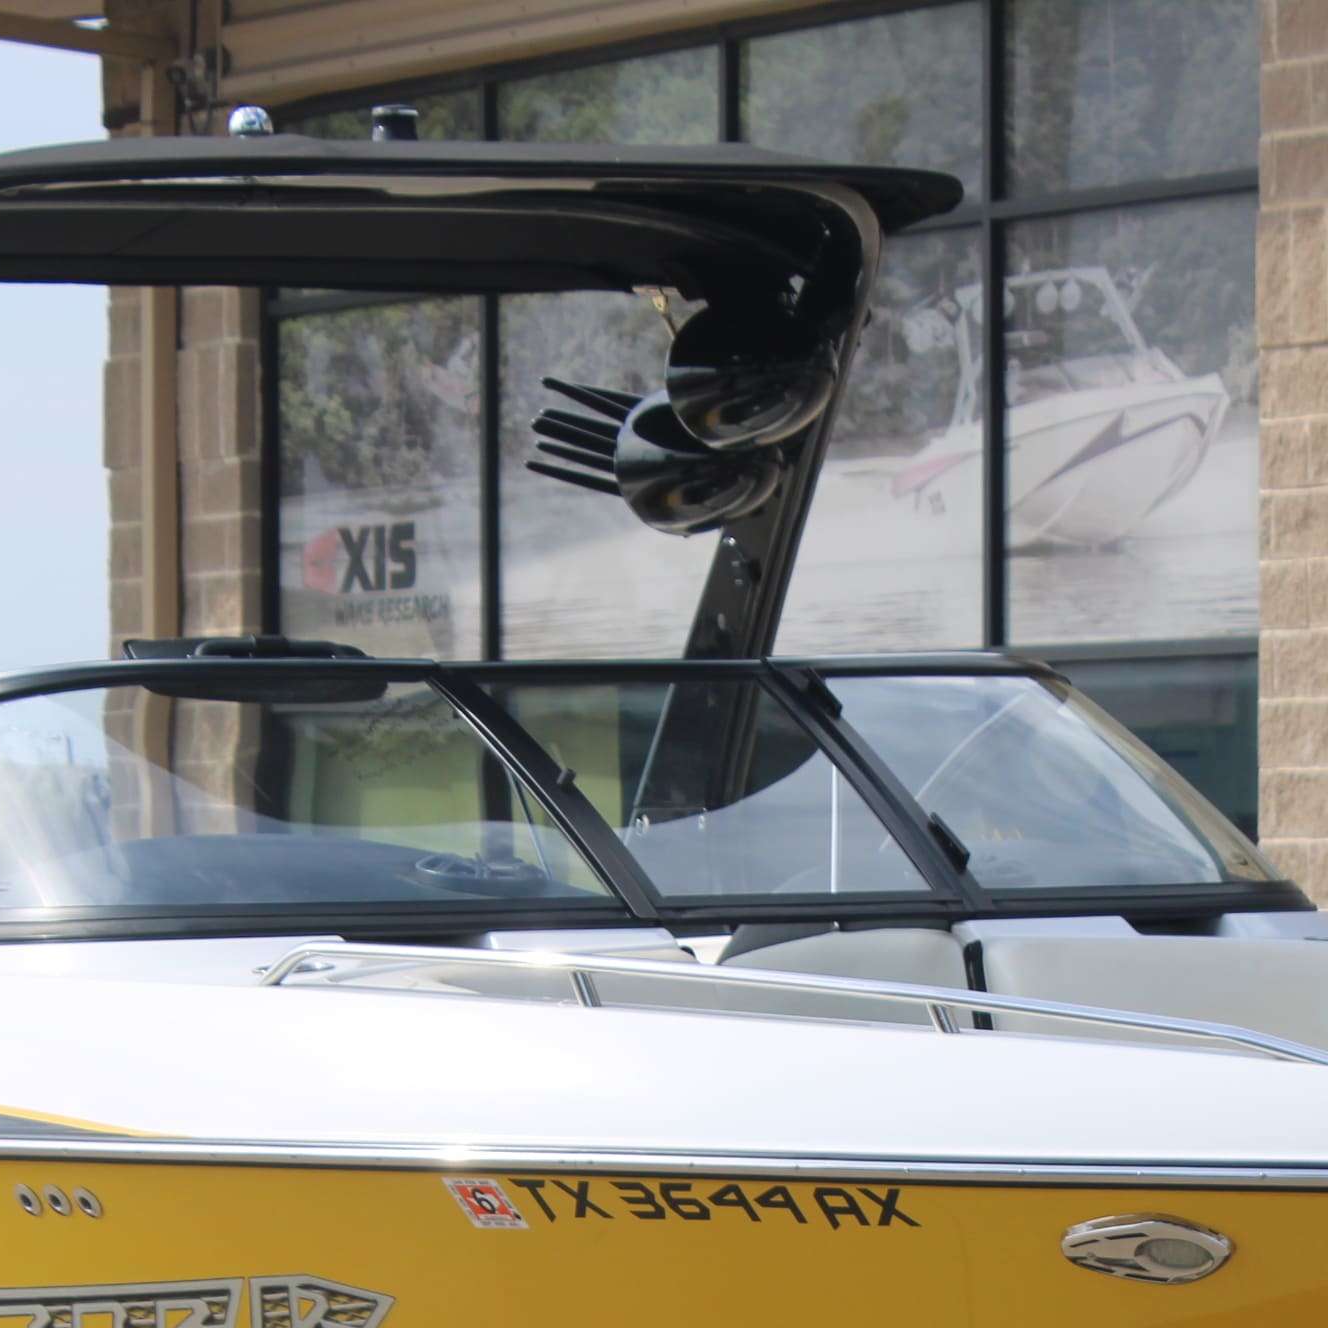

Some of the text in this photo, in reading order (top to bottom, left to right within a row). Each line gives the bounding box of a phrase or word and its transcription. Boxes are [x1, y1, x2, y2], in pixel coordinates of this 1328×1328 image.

[508, 1178, 923, 1230] TX 3644 AX
